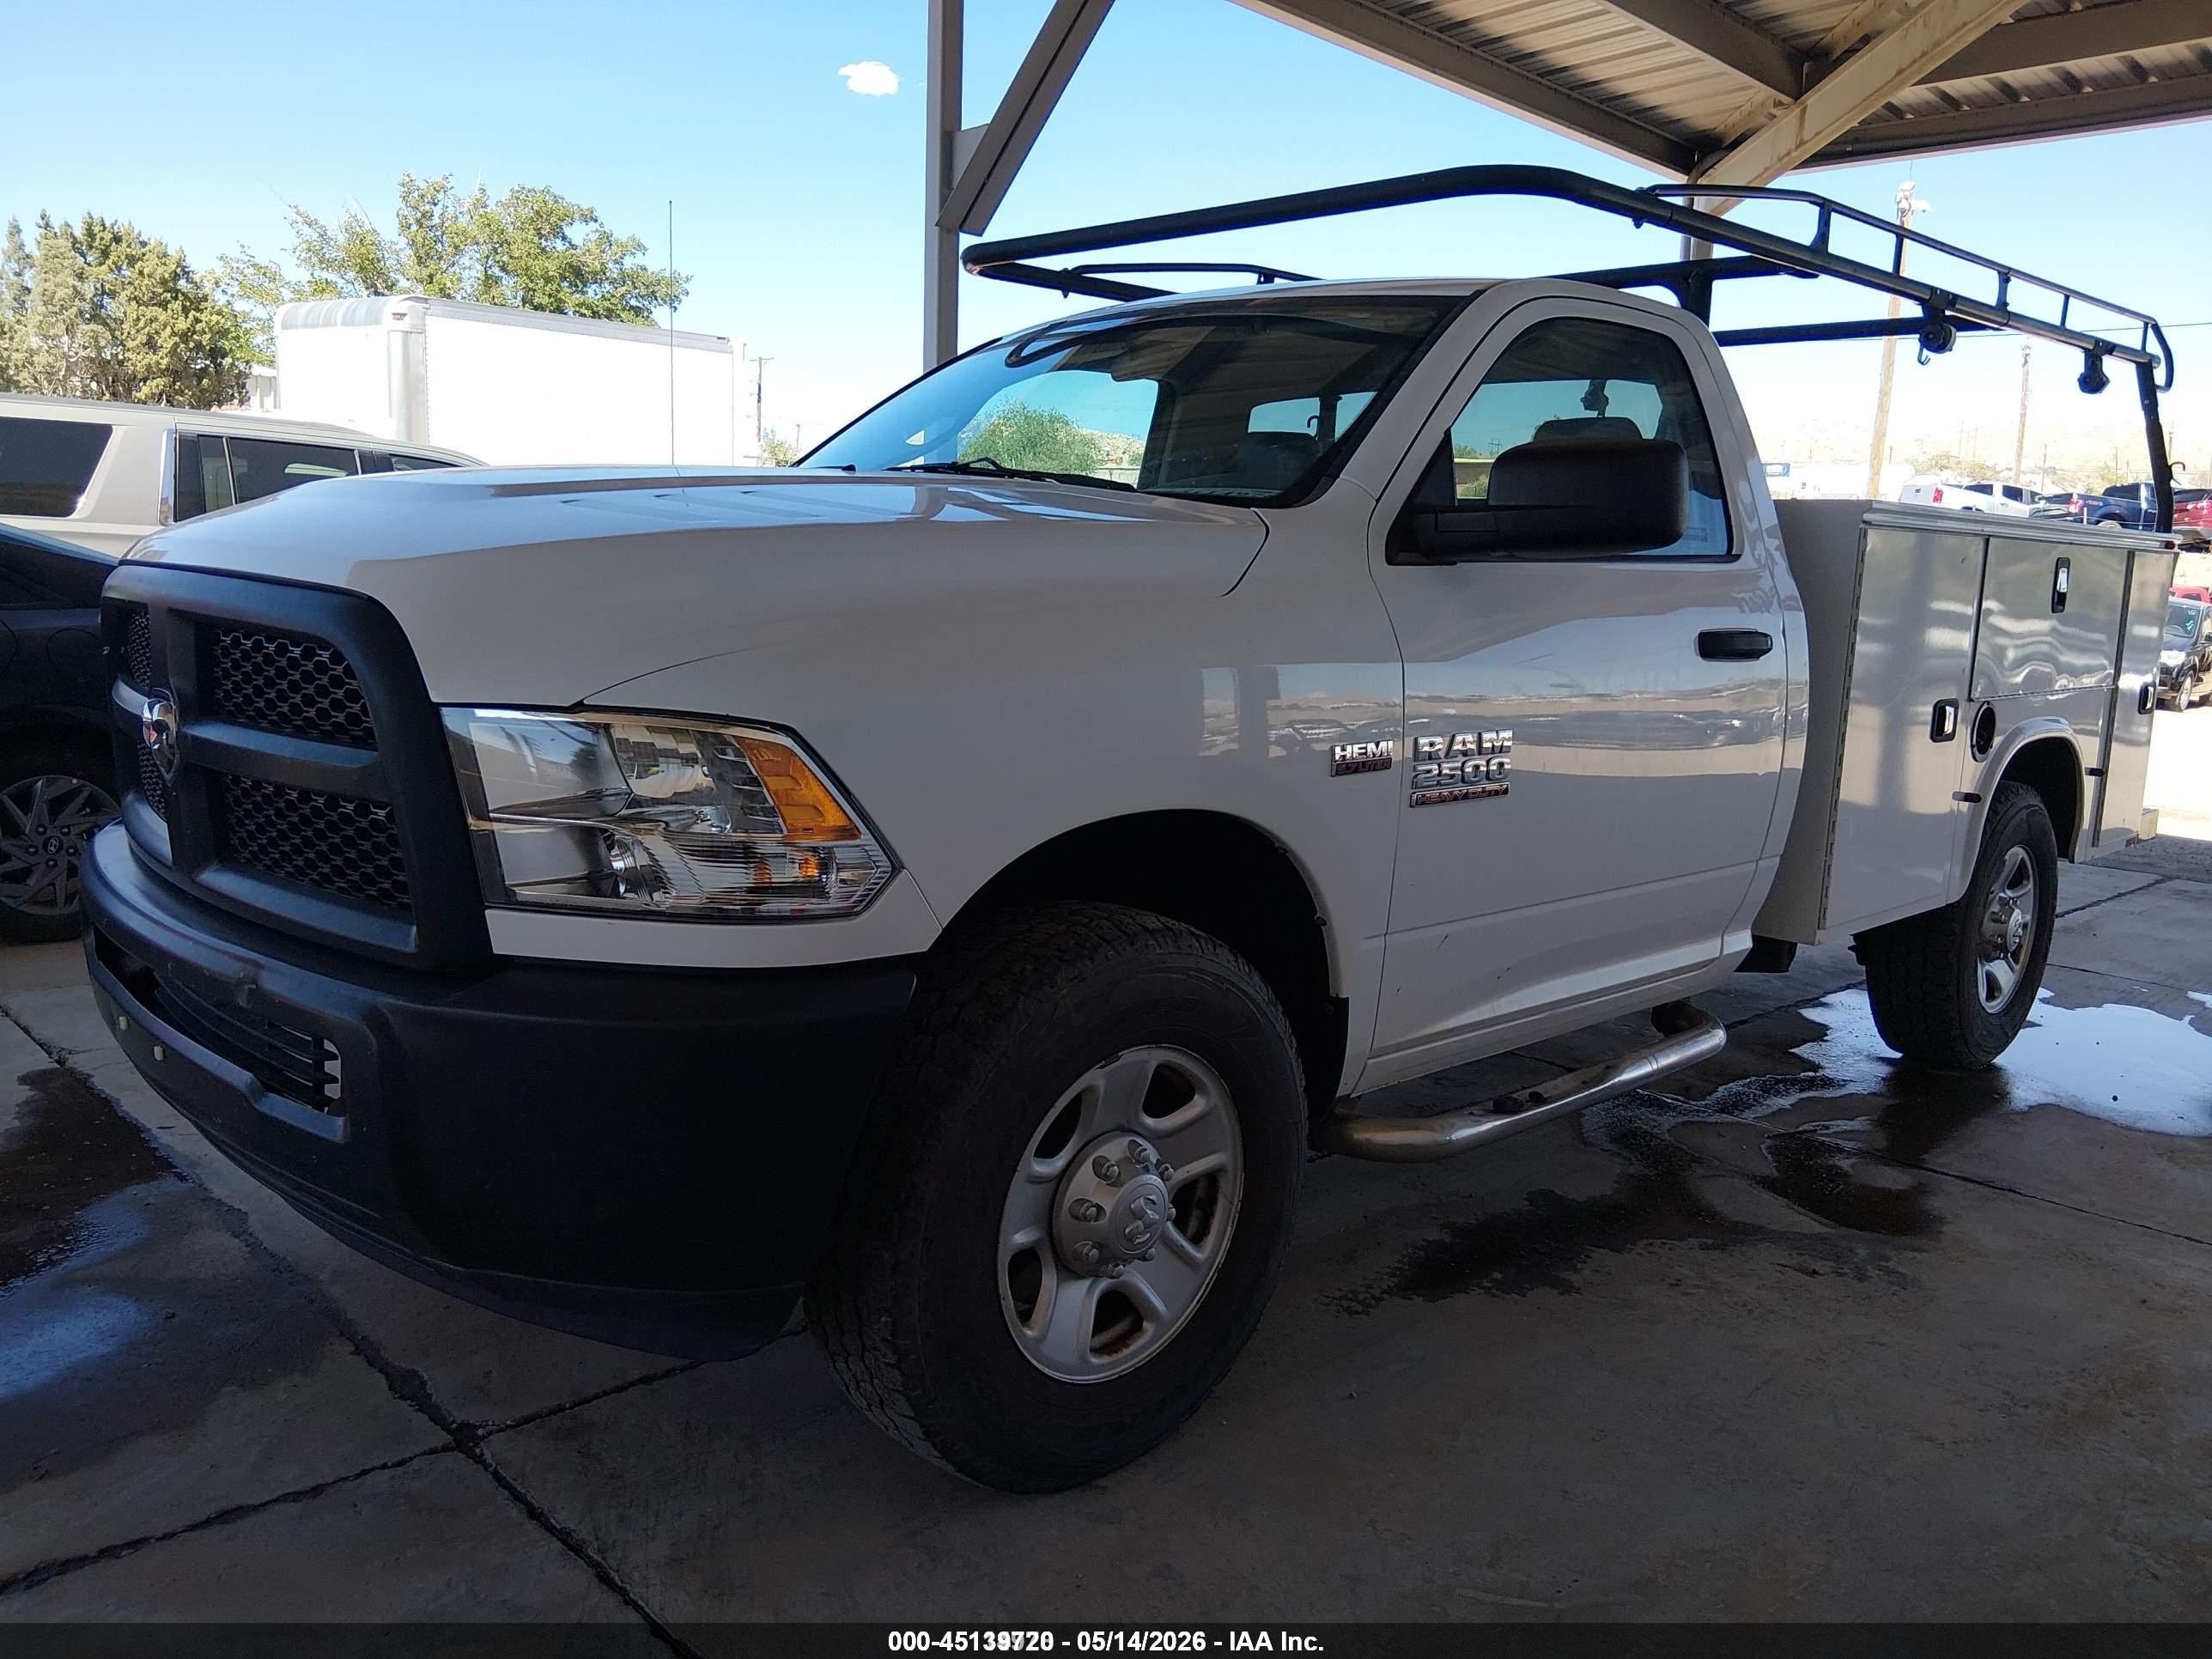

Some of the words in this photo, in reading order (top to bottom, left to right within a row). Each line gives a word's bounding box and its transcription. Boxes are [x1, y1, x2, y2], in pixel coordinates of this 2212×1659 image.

[1334, 740, 1394, 761] HEMI
[1415, 729, 1513, 762] RAM
[1413, 756, 1512, 789] 2500
[1418, 789, 1468, 805] HEAVY
[1469, 784, 1508, 798] DUTY
